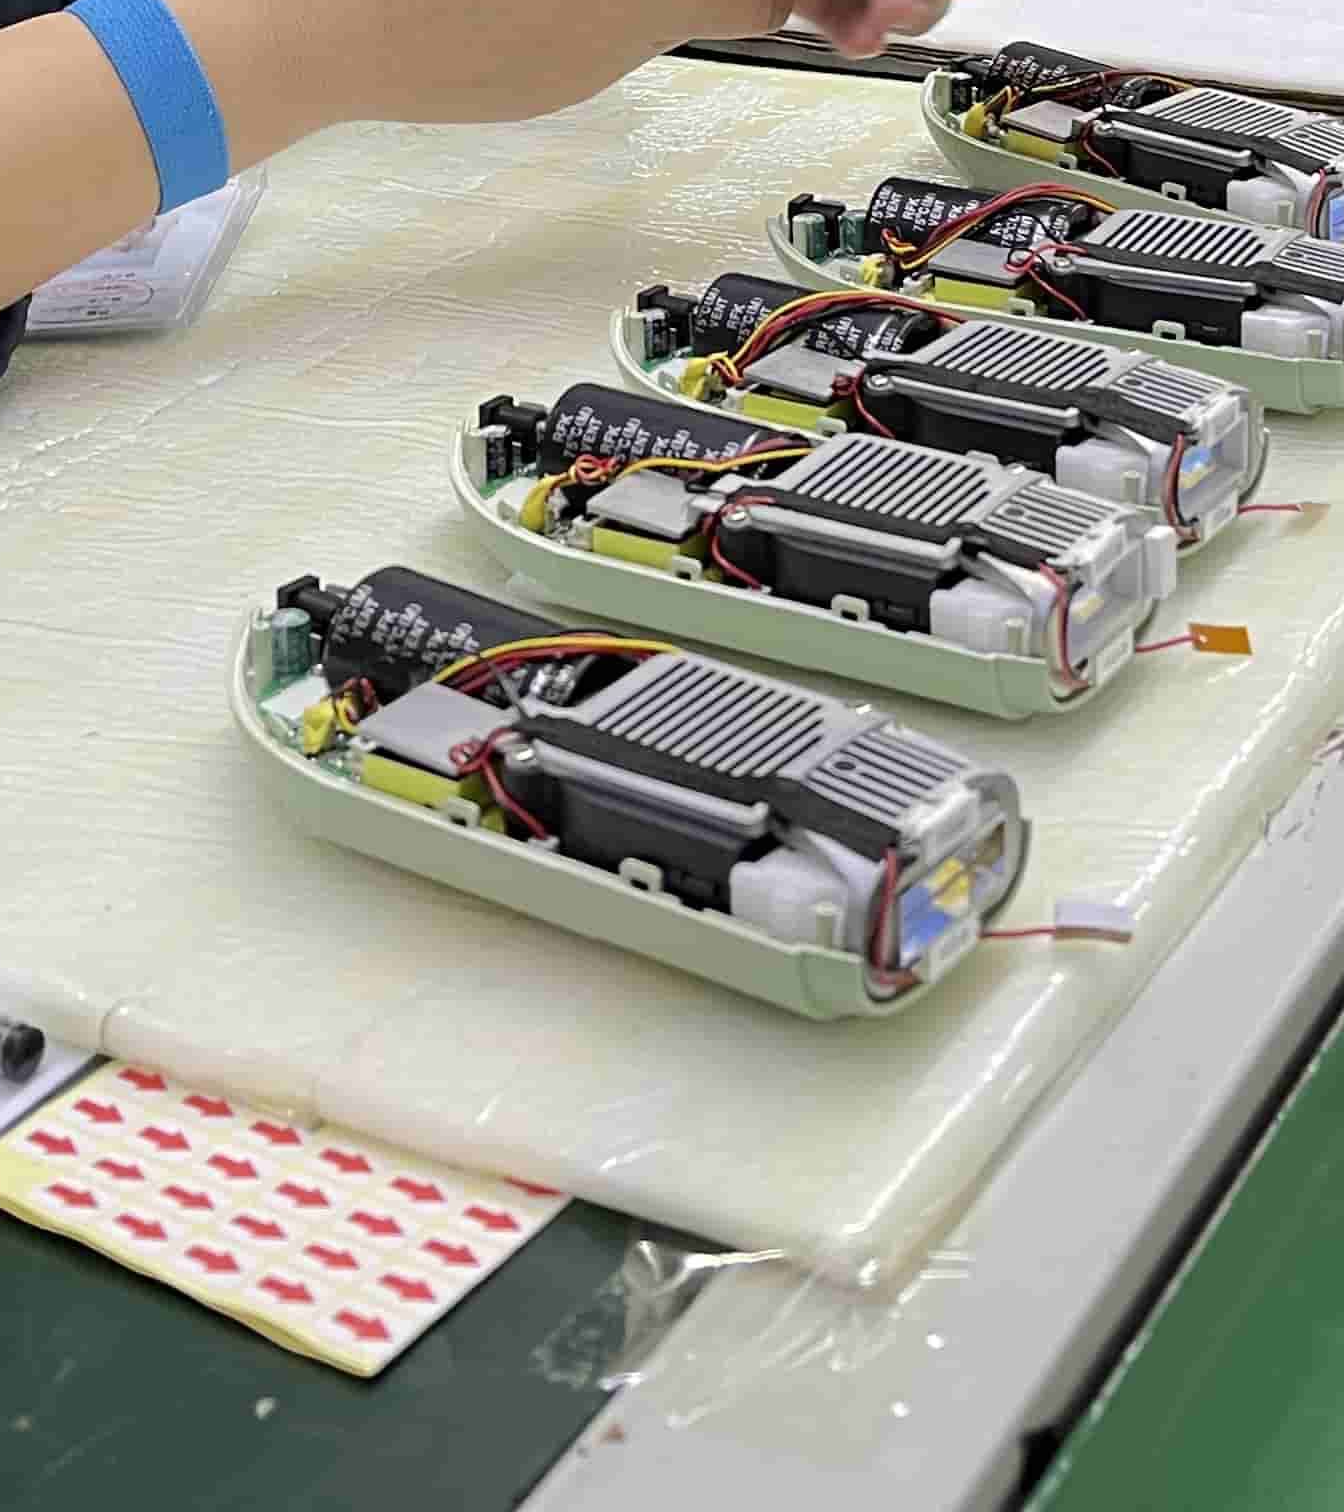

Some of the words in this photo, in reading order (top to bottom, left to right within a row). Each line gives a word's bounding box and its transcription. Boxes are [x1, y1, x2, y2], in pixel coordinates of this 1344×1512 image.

[885, 192, 904, 218] VENT
[928, 199, 946, 226] VENT
[709, 296, 729, 328] VENT
[580, 416, 602, 451] VENT
